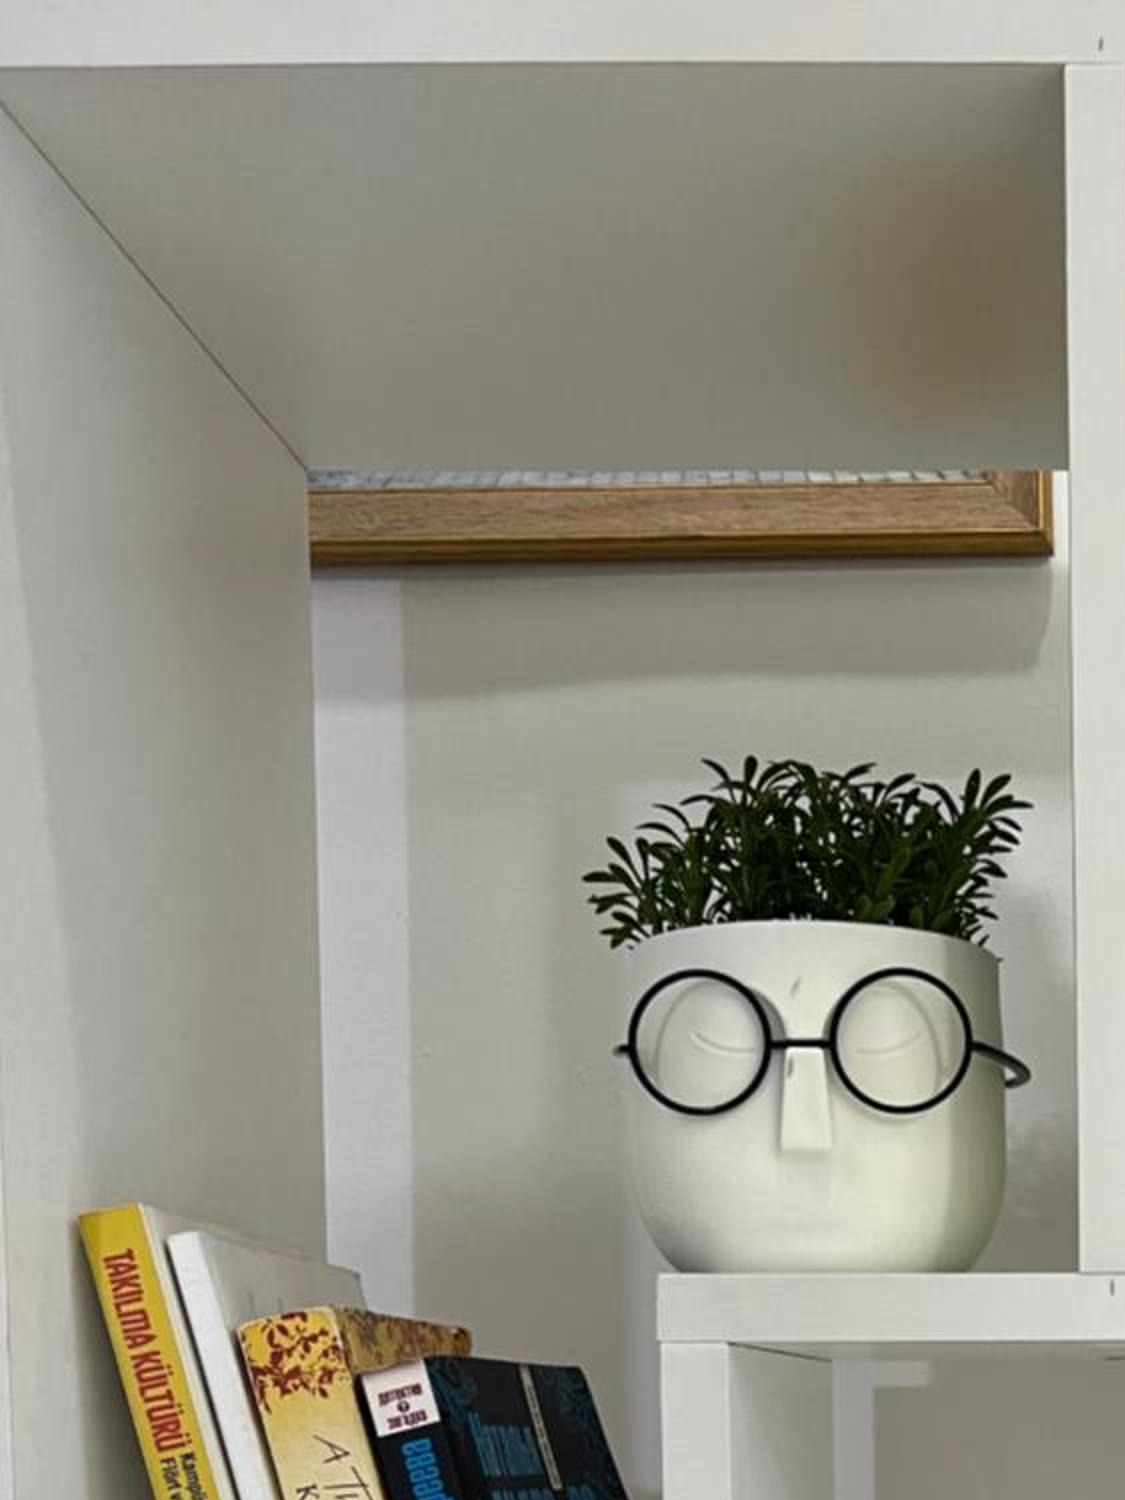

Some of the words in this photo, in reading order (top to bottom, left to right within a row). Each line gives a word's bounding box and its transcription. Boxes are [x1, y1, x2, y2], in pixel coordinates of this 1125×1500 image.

[103, 1248, 156, 1349] TAKILMA
[131, 1351, 192, 1453] KÜLTÜRÜ
[312, 1434, 350, 1464] A
